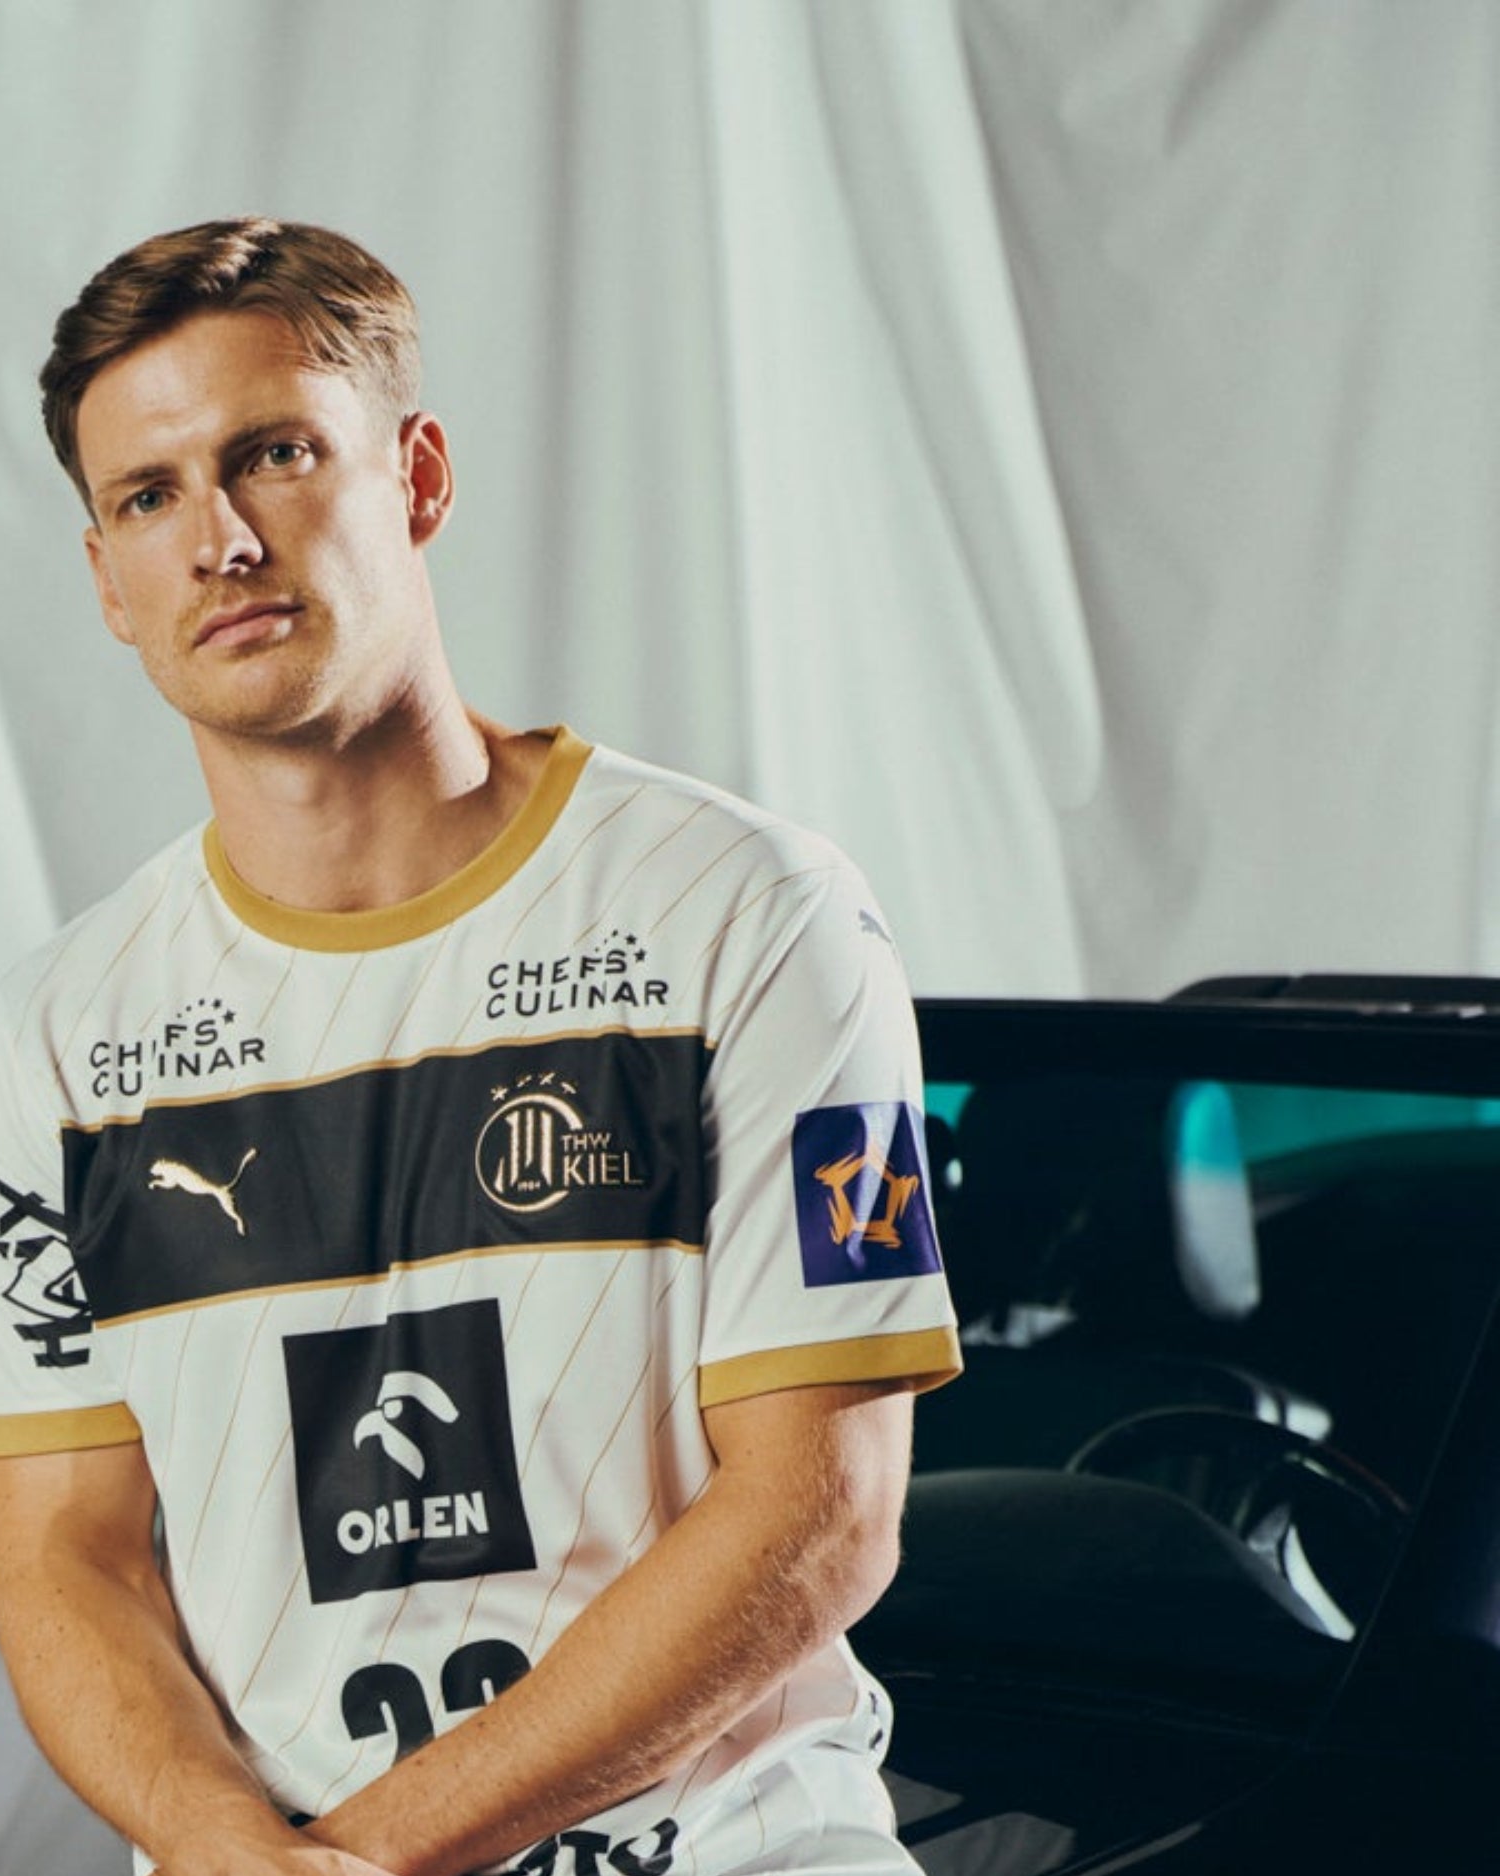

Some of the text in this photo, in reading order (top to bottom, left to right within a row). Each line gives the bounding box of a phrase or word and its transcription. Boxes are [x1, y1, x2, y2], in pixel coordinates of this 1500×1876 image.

[487, 949, 628, 990] CHEFS
[486, 979, 669, 1019] CULINAR
[89, 1018, 220, 1069] CHFS
[92, 1037, 266, 1098] CUINAR
[561, 1132, 612, 1152] THW
[564, 1151, 644, 1187] KIEL
[337, 1491, 489, 1554] ORLEN
